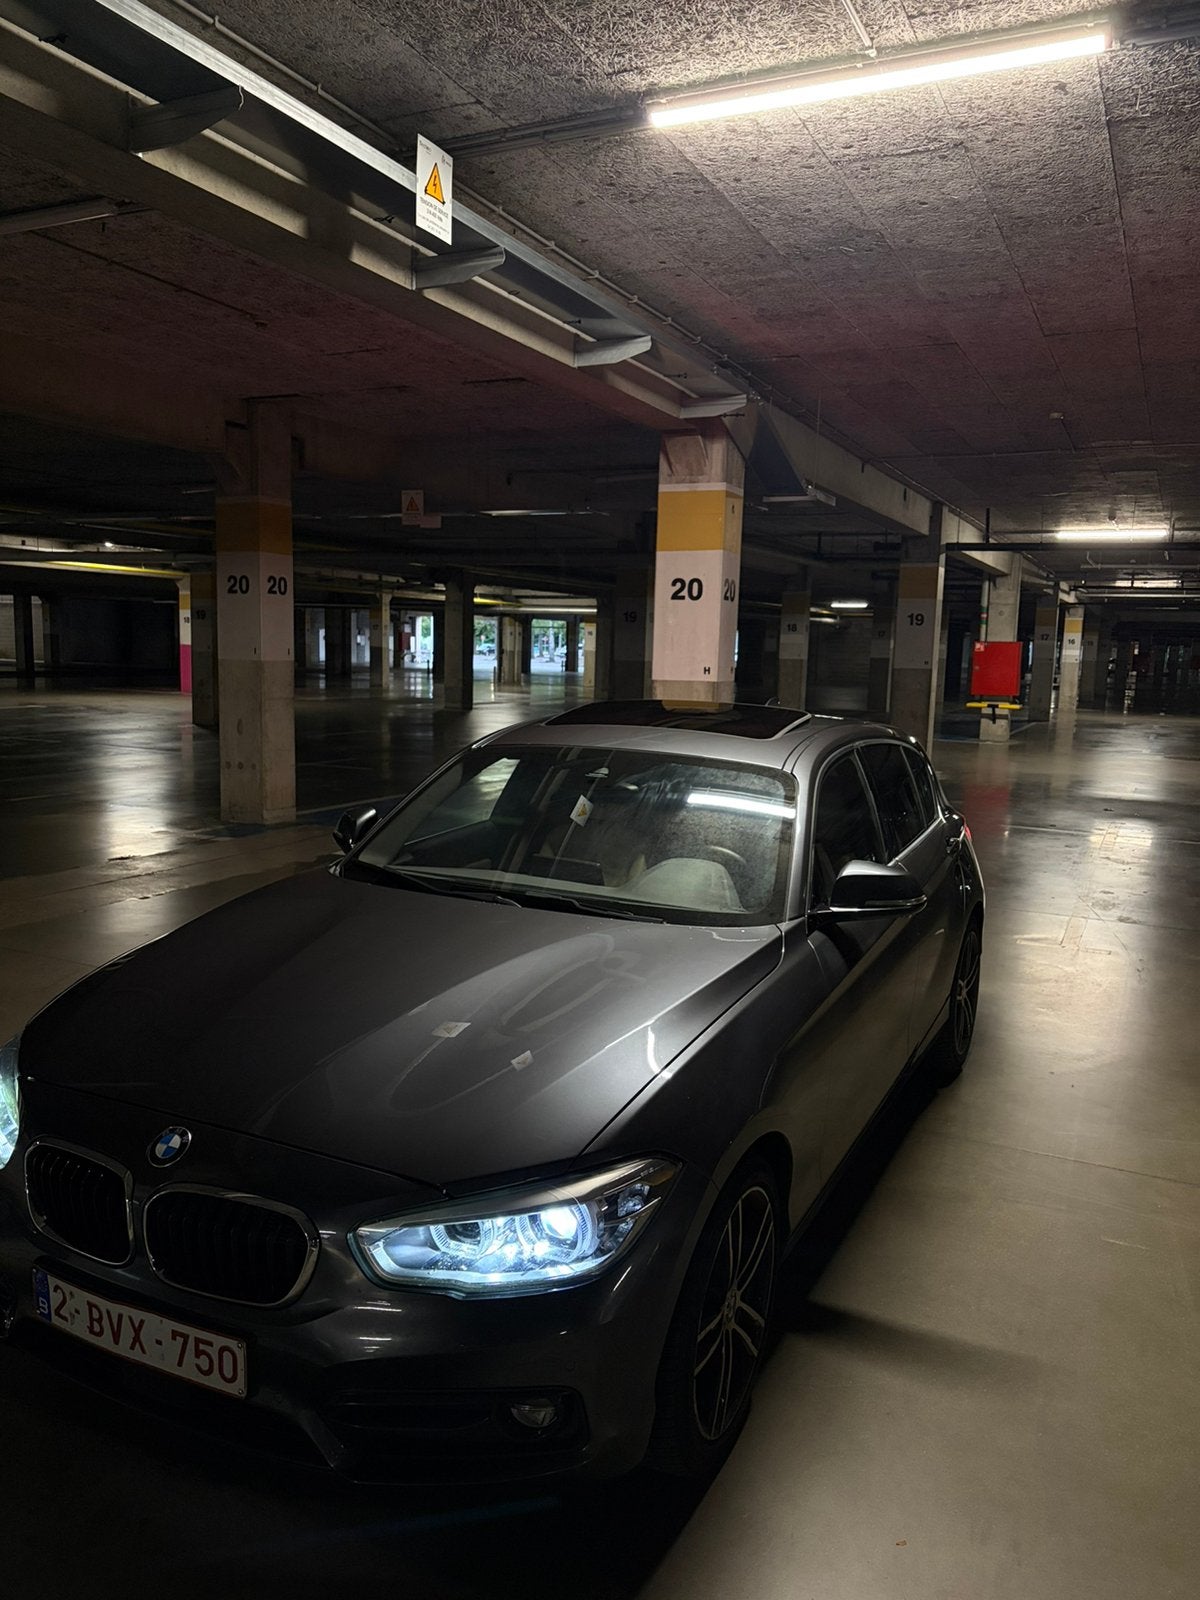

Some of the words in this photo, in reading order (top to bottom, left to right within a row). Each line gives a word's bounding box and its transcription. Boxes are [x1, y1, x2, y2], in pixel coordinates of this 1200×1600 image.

[227, 575, 250, 594] 20
[267, 576, 288, 595] 20
[671, 578, 704, 601] 20
[724, 578, 736, 602] 20
[623, 611, 637, 623] 19
[908, 613, 925, 626] 19
[703, 666, 711, 675] H
[52, 1284, 239, 1384] 2-BVX-750
